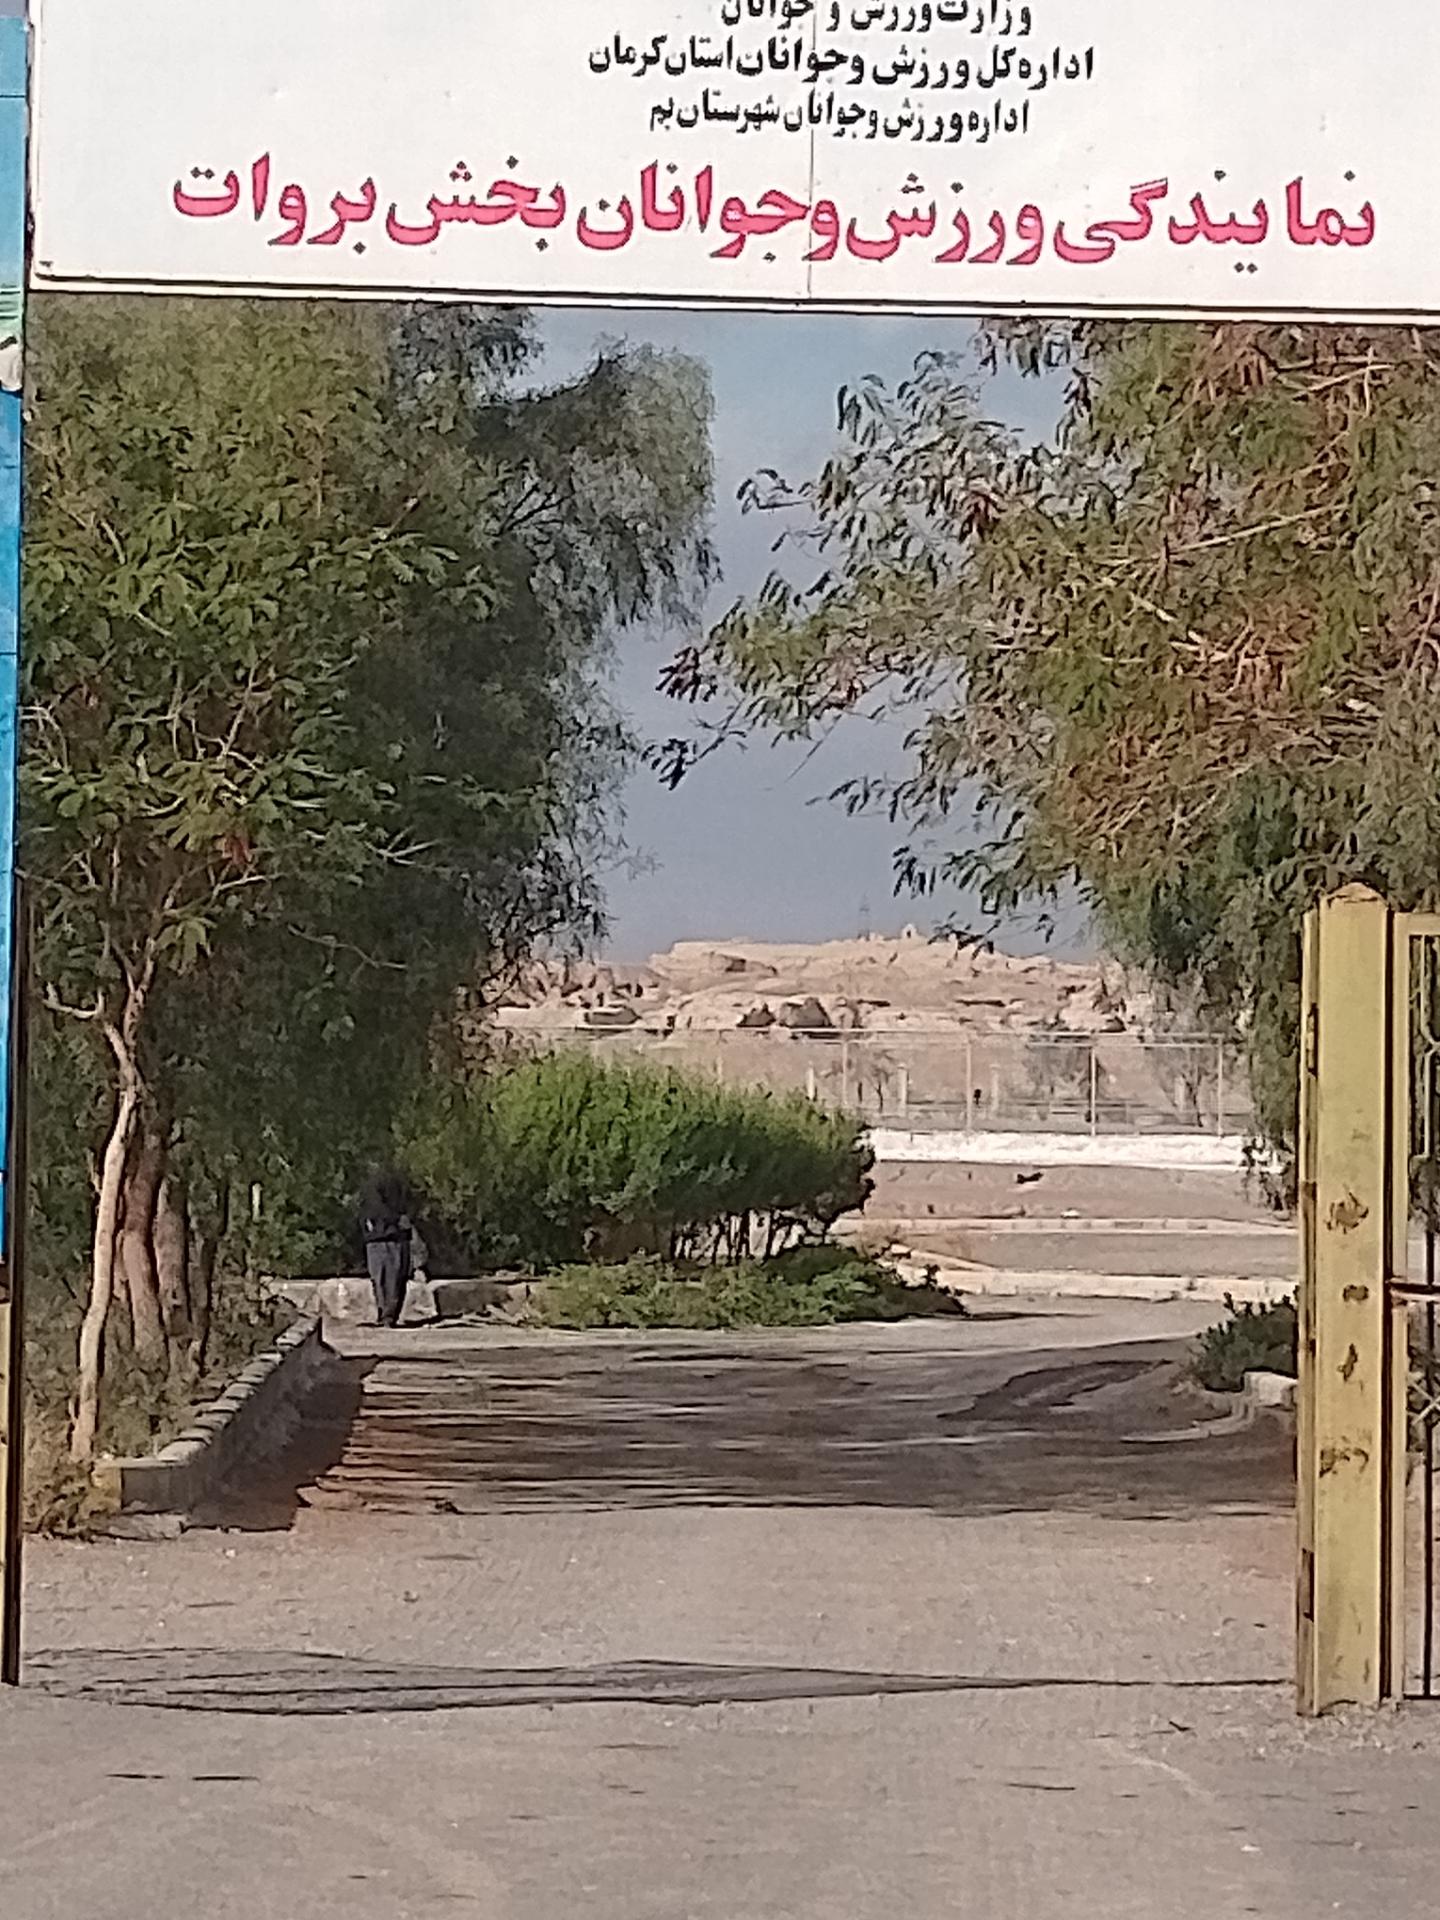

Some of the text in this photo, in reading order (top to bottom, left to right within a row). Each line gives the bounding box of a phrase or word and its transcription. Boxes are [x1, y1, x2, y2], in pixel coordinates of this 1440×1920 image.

[588, 33, 667, 77] کرمان
[665, 35, 733, 76] استان
[872, 45, 969, 89] ورزش
[976, 45, 1016, 88] کل
[1019, 46, 1094, 90] اداره
[650, 97, 674, 132] بم
[676, 88, 780, 134] شهرستان
[883, 98, 963, 143] ورزش
[968, 98, 1029, 143] اداره
[174, 152, 376, 255] بروات
[386, 156, 566, 251] بخش
[846, 173, 1044, 265] ورزش
[1053, 171, 1376, 274] نمایندگی
